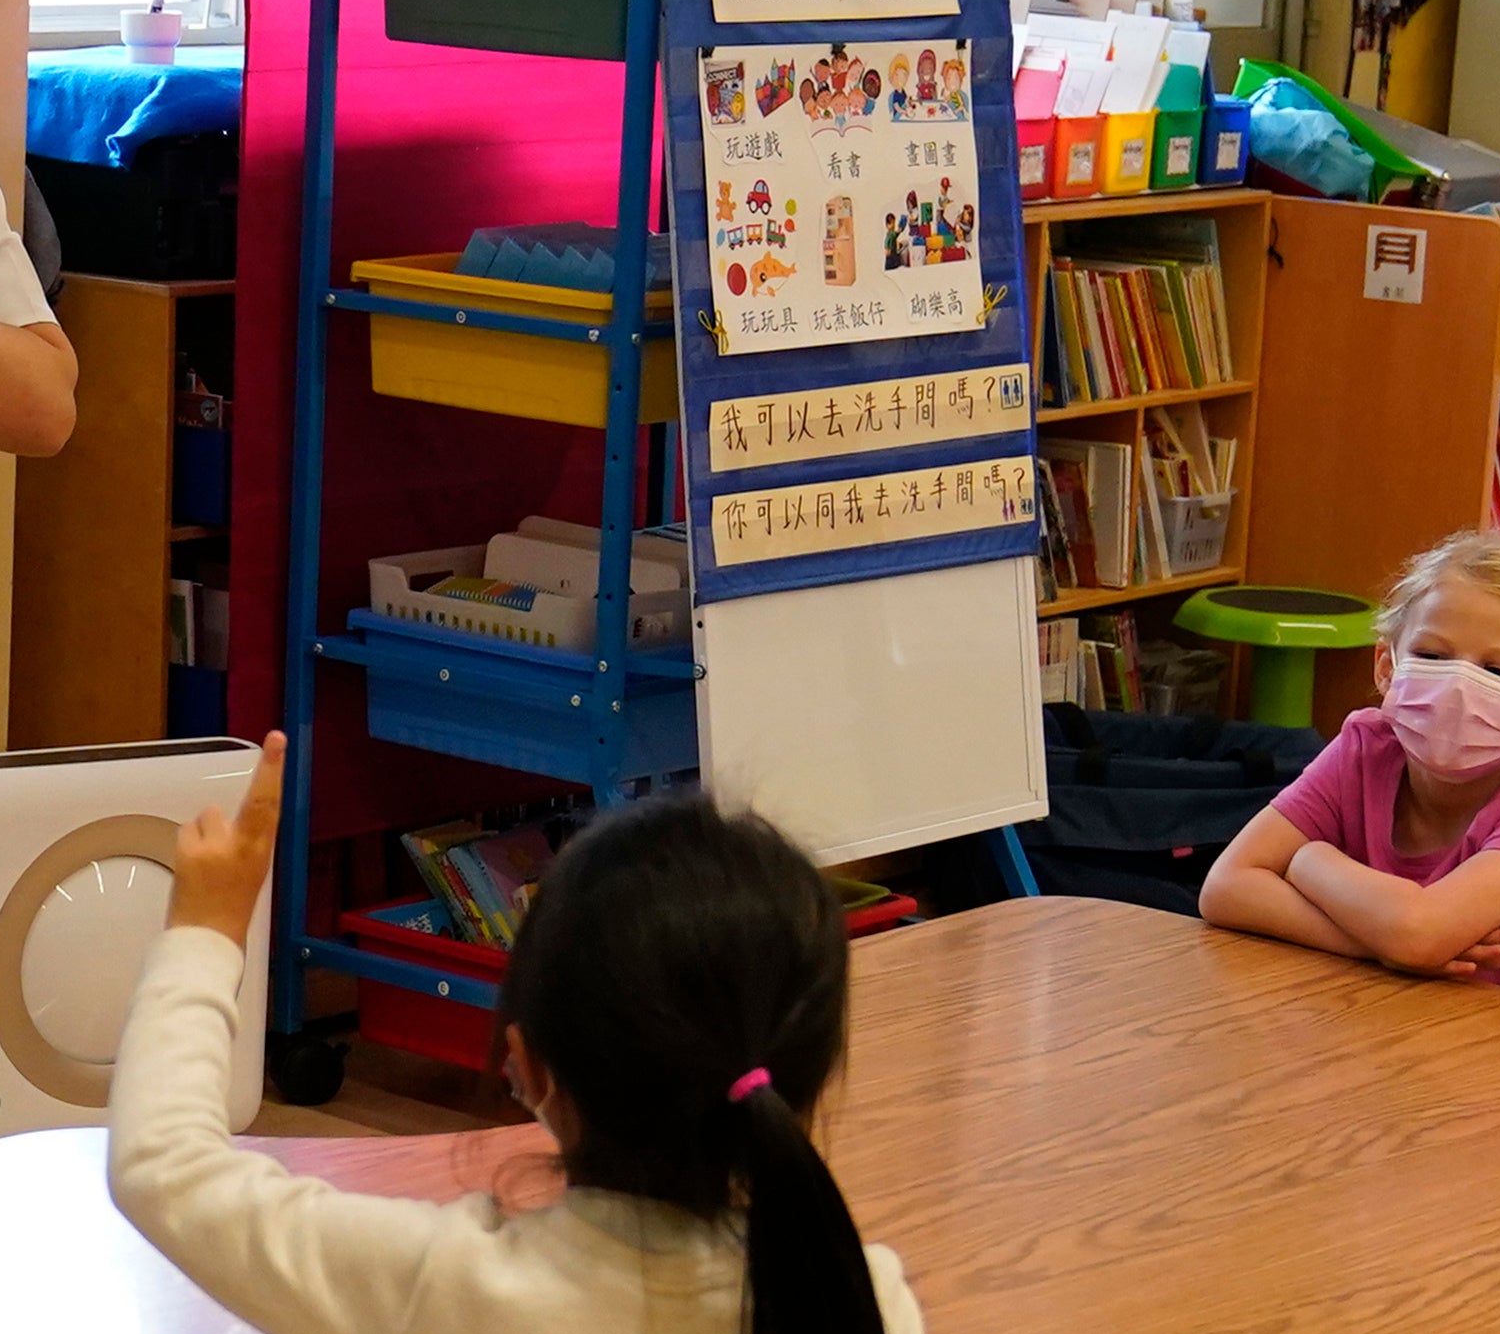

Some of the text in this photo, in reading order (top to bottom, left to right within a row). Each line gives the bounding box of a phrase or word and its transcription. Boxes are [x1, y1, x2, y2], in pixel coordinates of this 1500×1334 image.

[726, 131, 783, 160] 玩遊戲
[828, 152, 861, 179] 看書
[741, 307, 799, 333] 玩玩具
[813, 301, 885, 331] 玩煮飯仔
